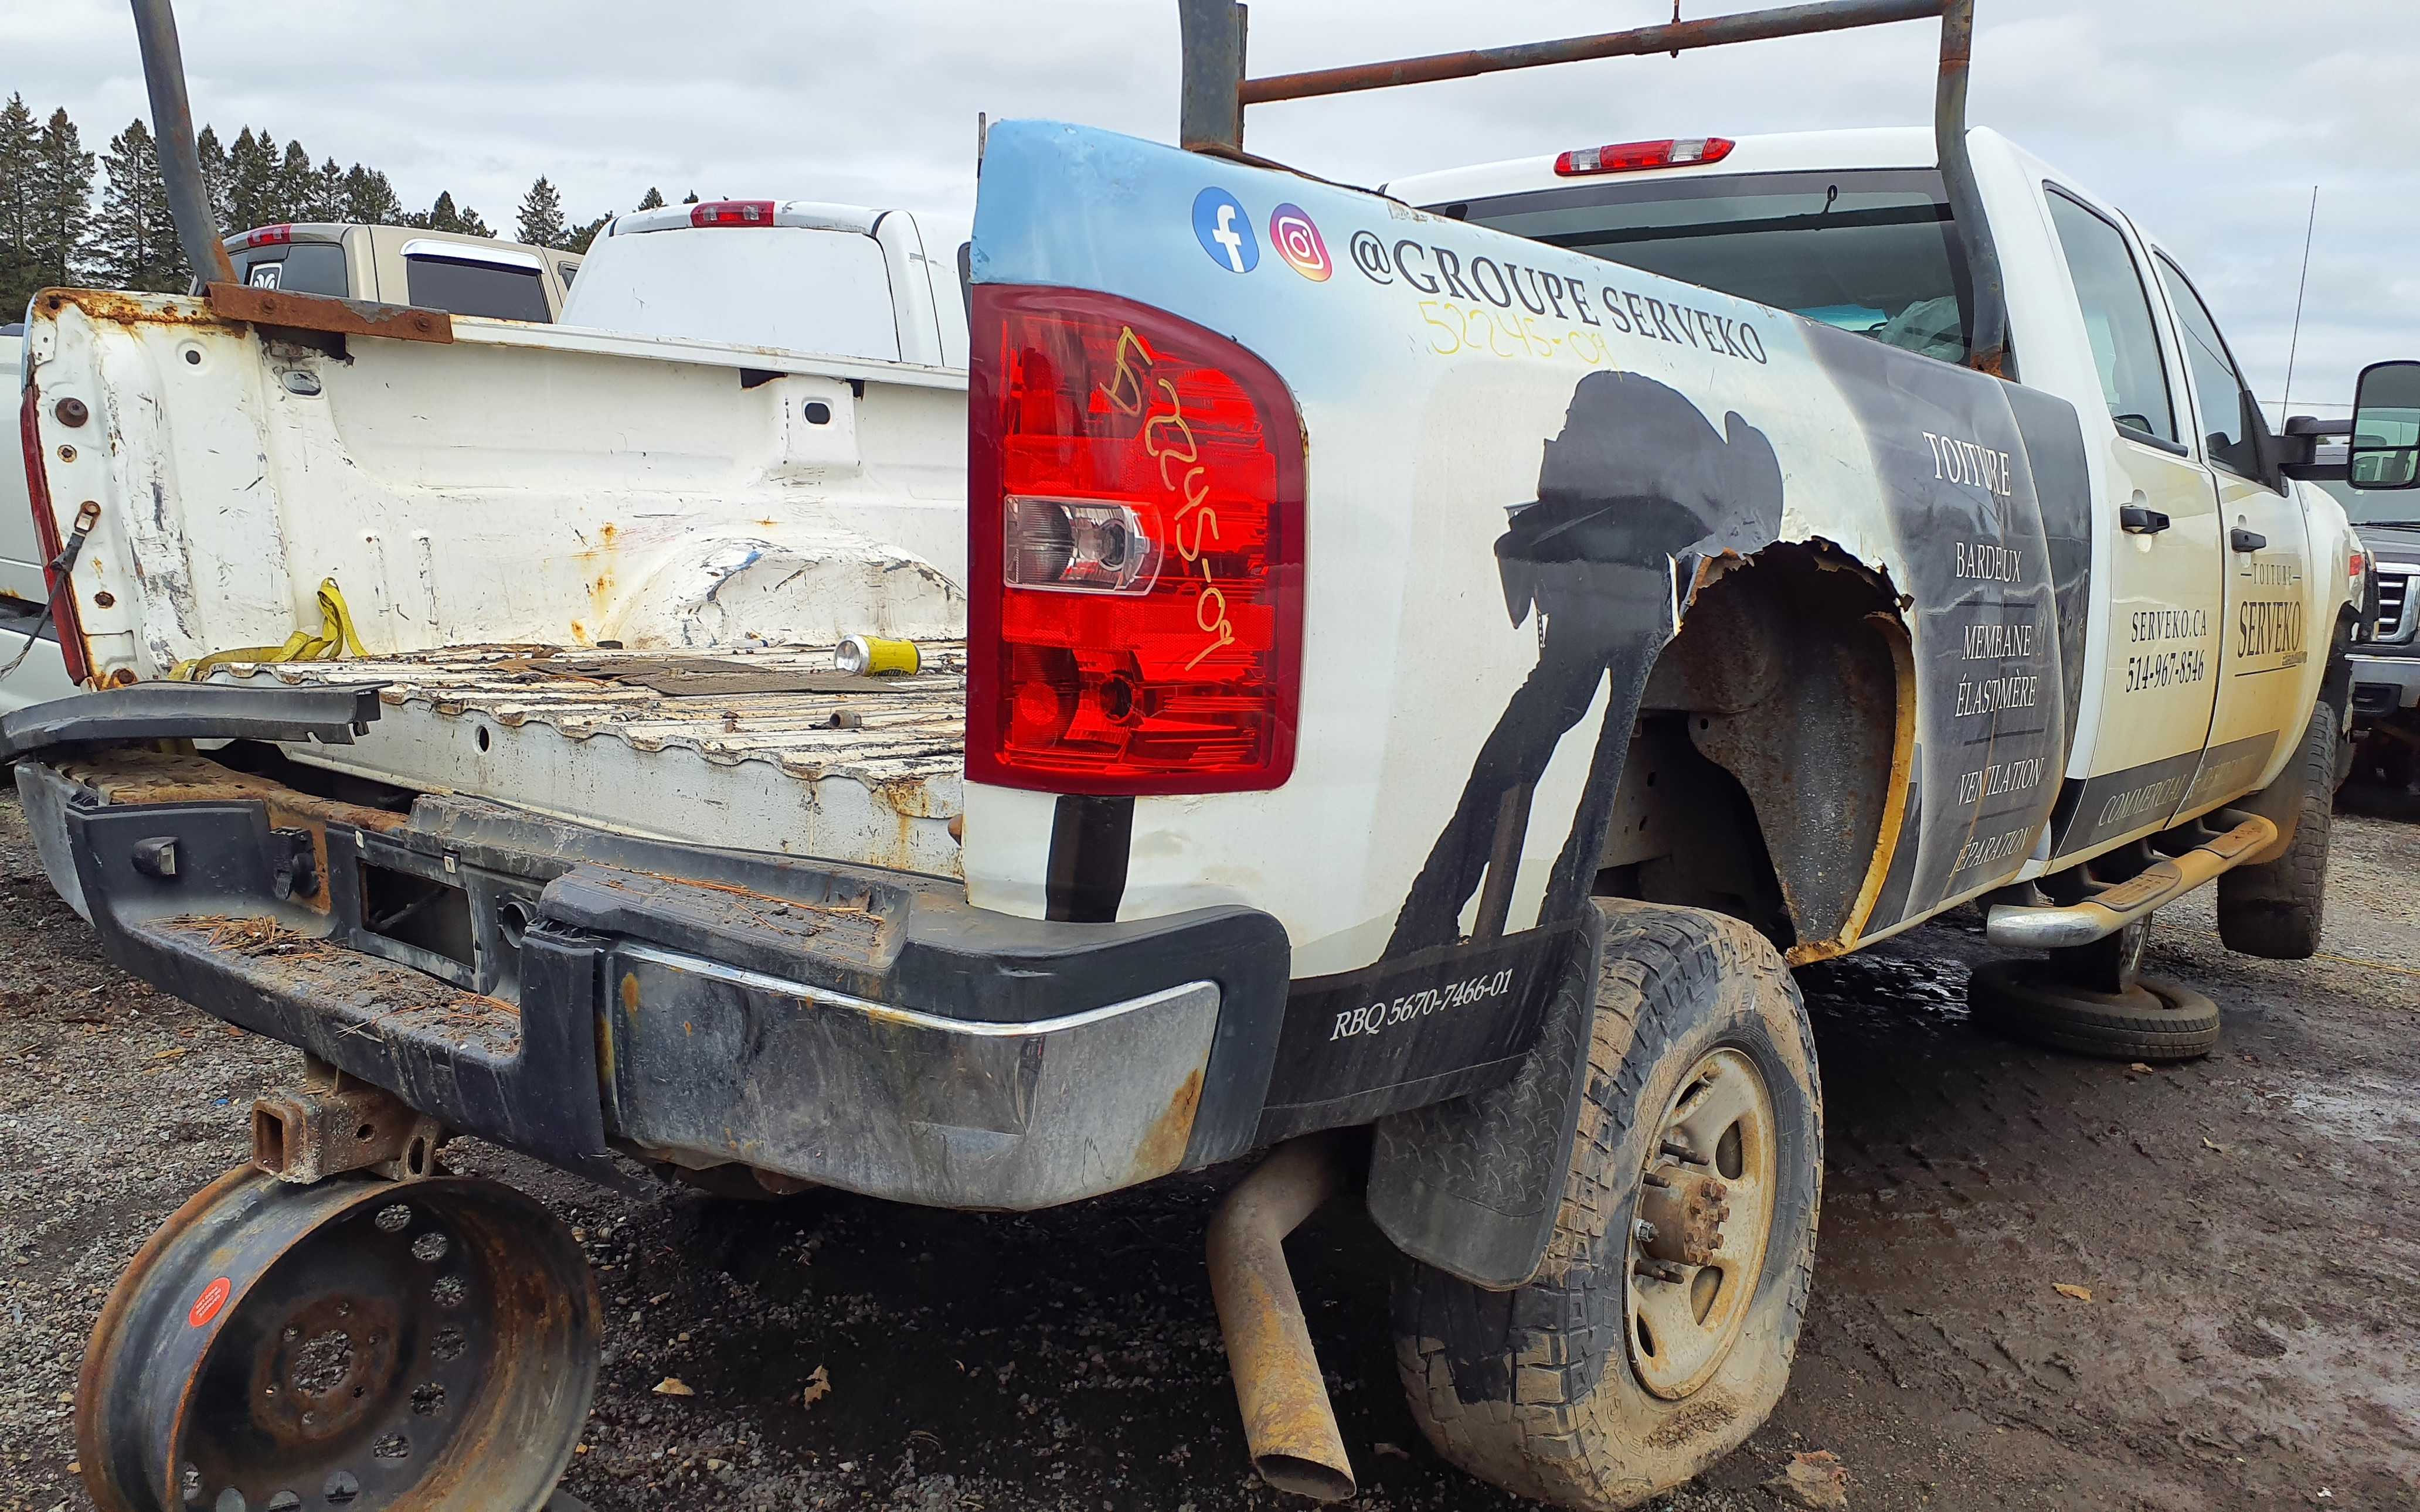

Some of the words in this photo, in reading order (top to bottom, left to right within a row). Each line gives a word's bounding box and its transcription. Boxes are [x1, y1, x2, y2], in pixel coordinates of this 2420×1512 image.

[1350, 229, 1601, 328] @GROUPE
[1602, 286, 1768, 365] SERVEKO
[1418, 299, 1623, 383] 52245-09
[1922, 431, 2011, 496] TOITURE
[1956, 542, 2022, 583] BARDEUX
[2253, 563, 2292, 585] TOITURE
[2131, 609, 2207, 643] SERVEKO.CA
[2237, 600, 2301, 658] SERVEKO
[2125, 649, 2205, 693] 514-967-8546
[1958, 757, 2045, 806] VENTILATION
[1330, 1002, 1386, 1041] RBQ
[1387, 968, 1514, 1026] 5670-7466-01
